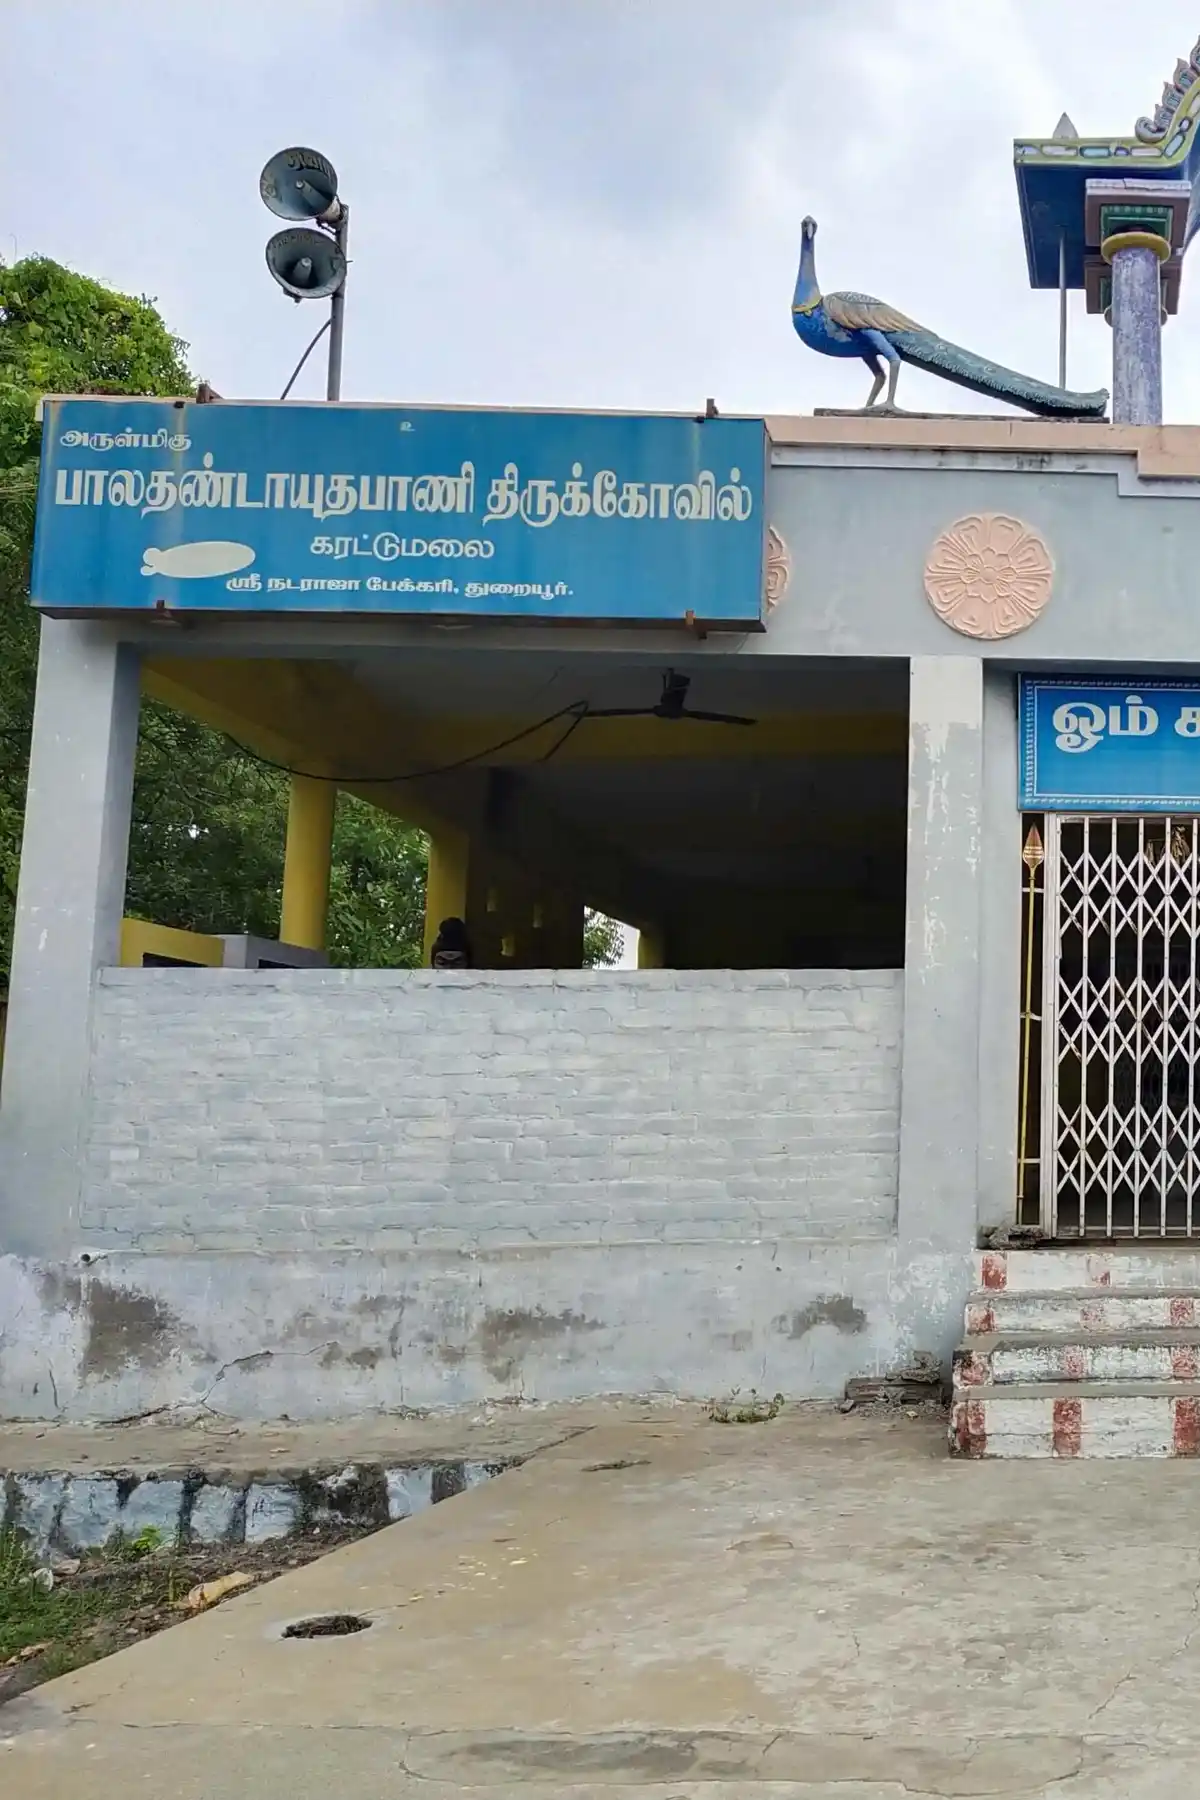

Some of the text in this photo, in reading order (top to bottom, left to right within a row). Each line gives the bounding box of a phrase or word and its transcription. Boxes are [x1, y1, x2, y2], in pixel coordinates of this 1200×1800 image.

[59, 427, 192, 451] அருள்மிகு
[55, 452, 752, 527] பாலதண்டாயுதபாணி திருக்கோவில்
[310, 532, 495, 561] கரட்டுமலை
[267, 577, 361, 593] நடராஜா
[366, 576, 459, 594] பேக்கரி,
[1052, 695, 1159, 752] ஓம்
